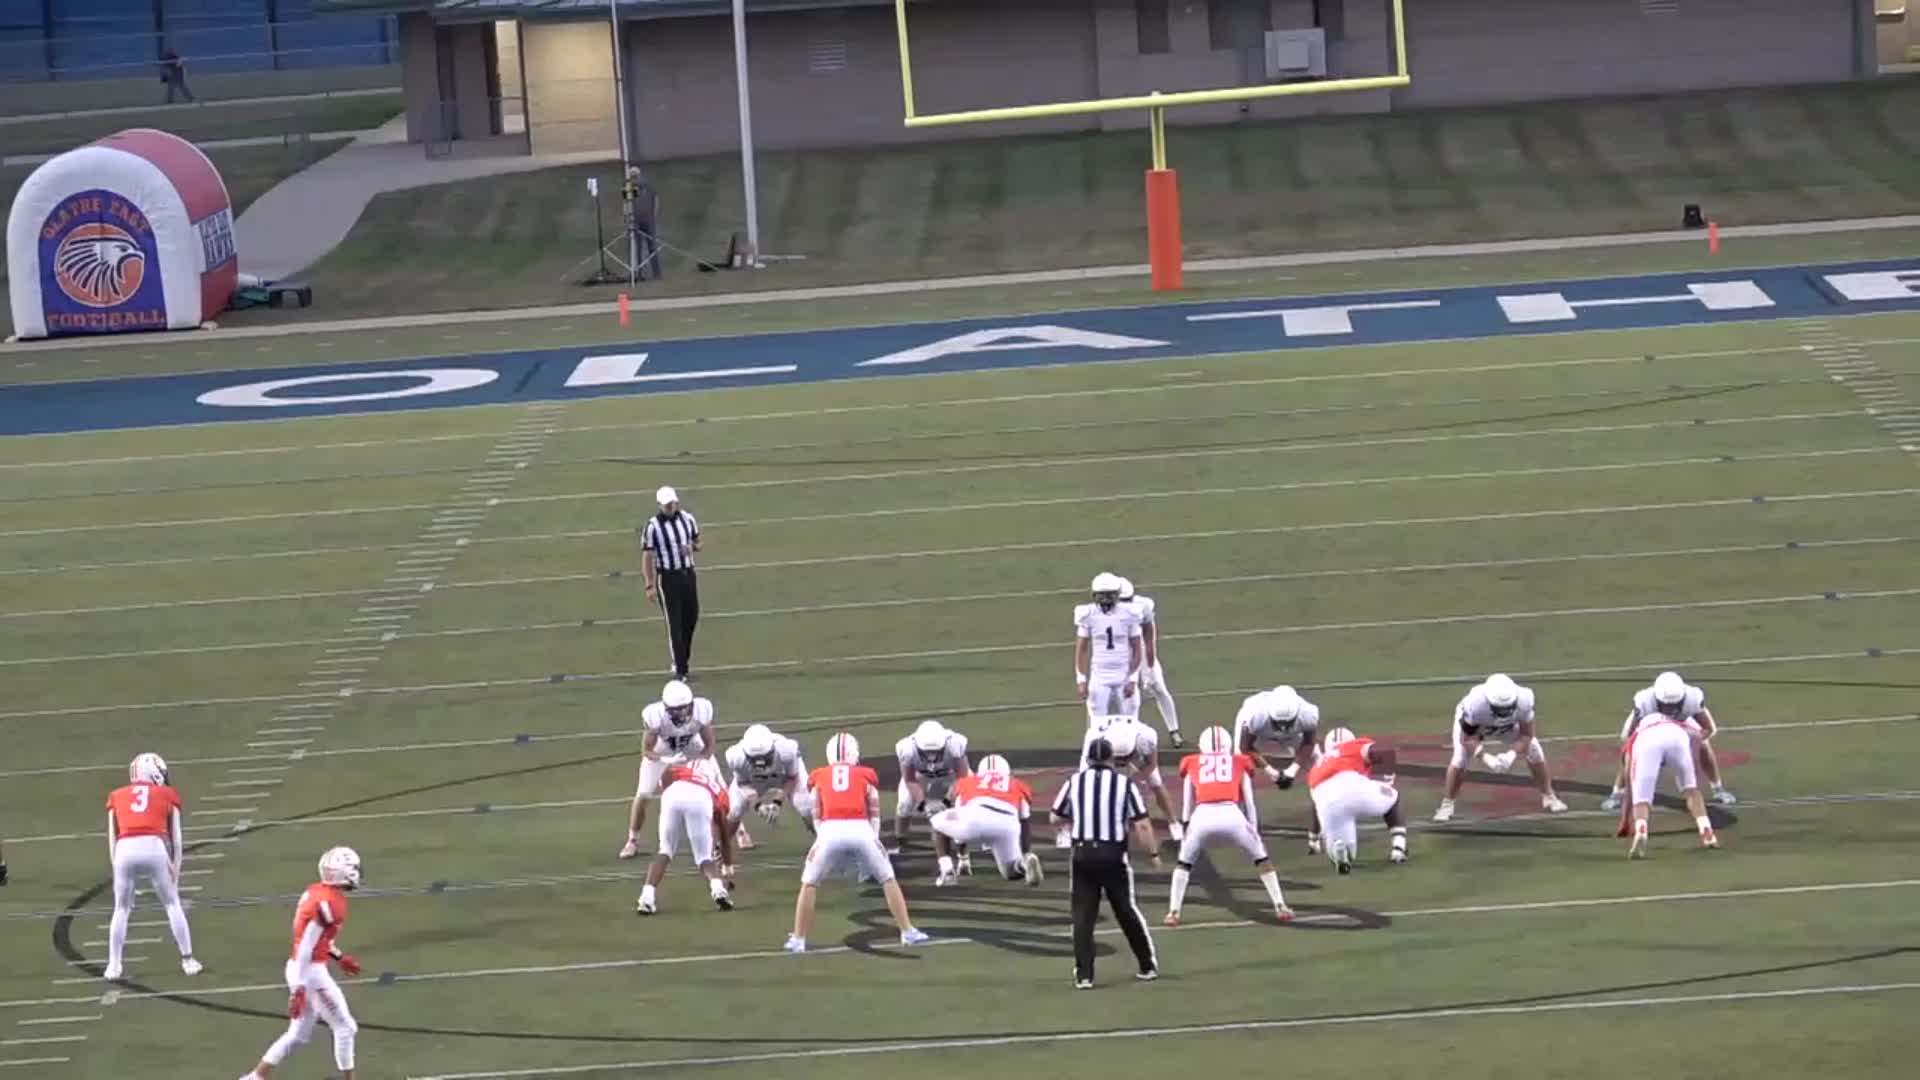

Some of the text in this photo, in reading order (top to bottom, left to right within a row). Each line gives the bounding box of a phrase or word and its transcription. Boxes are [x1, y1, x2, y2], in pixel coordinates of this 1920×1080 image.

[1105, 626, 1116, 650] 1
[831, 765, 850, 792] 8
[1198, 755, 1232, 784] 28
[130, 785, 149, 812] 3
